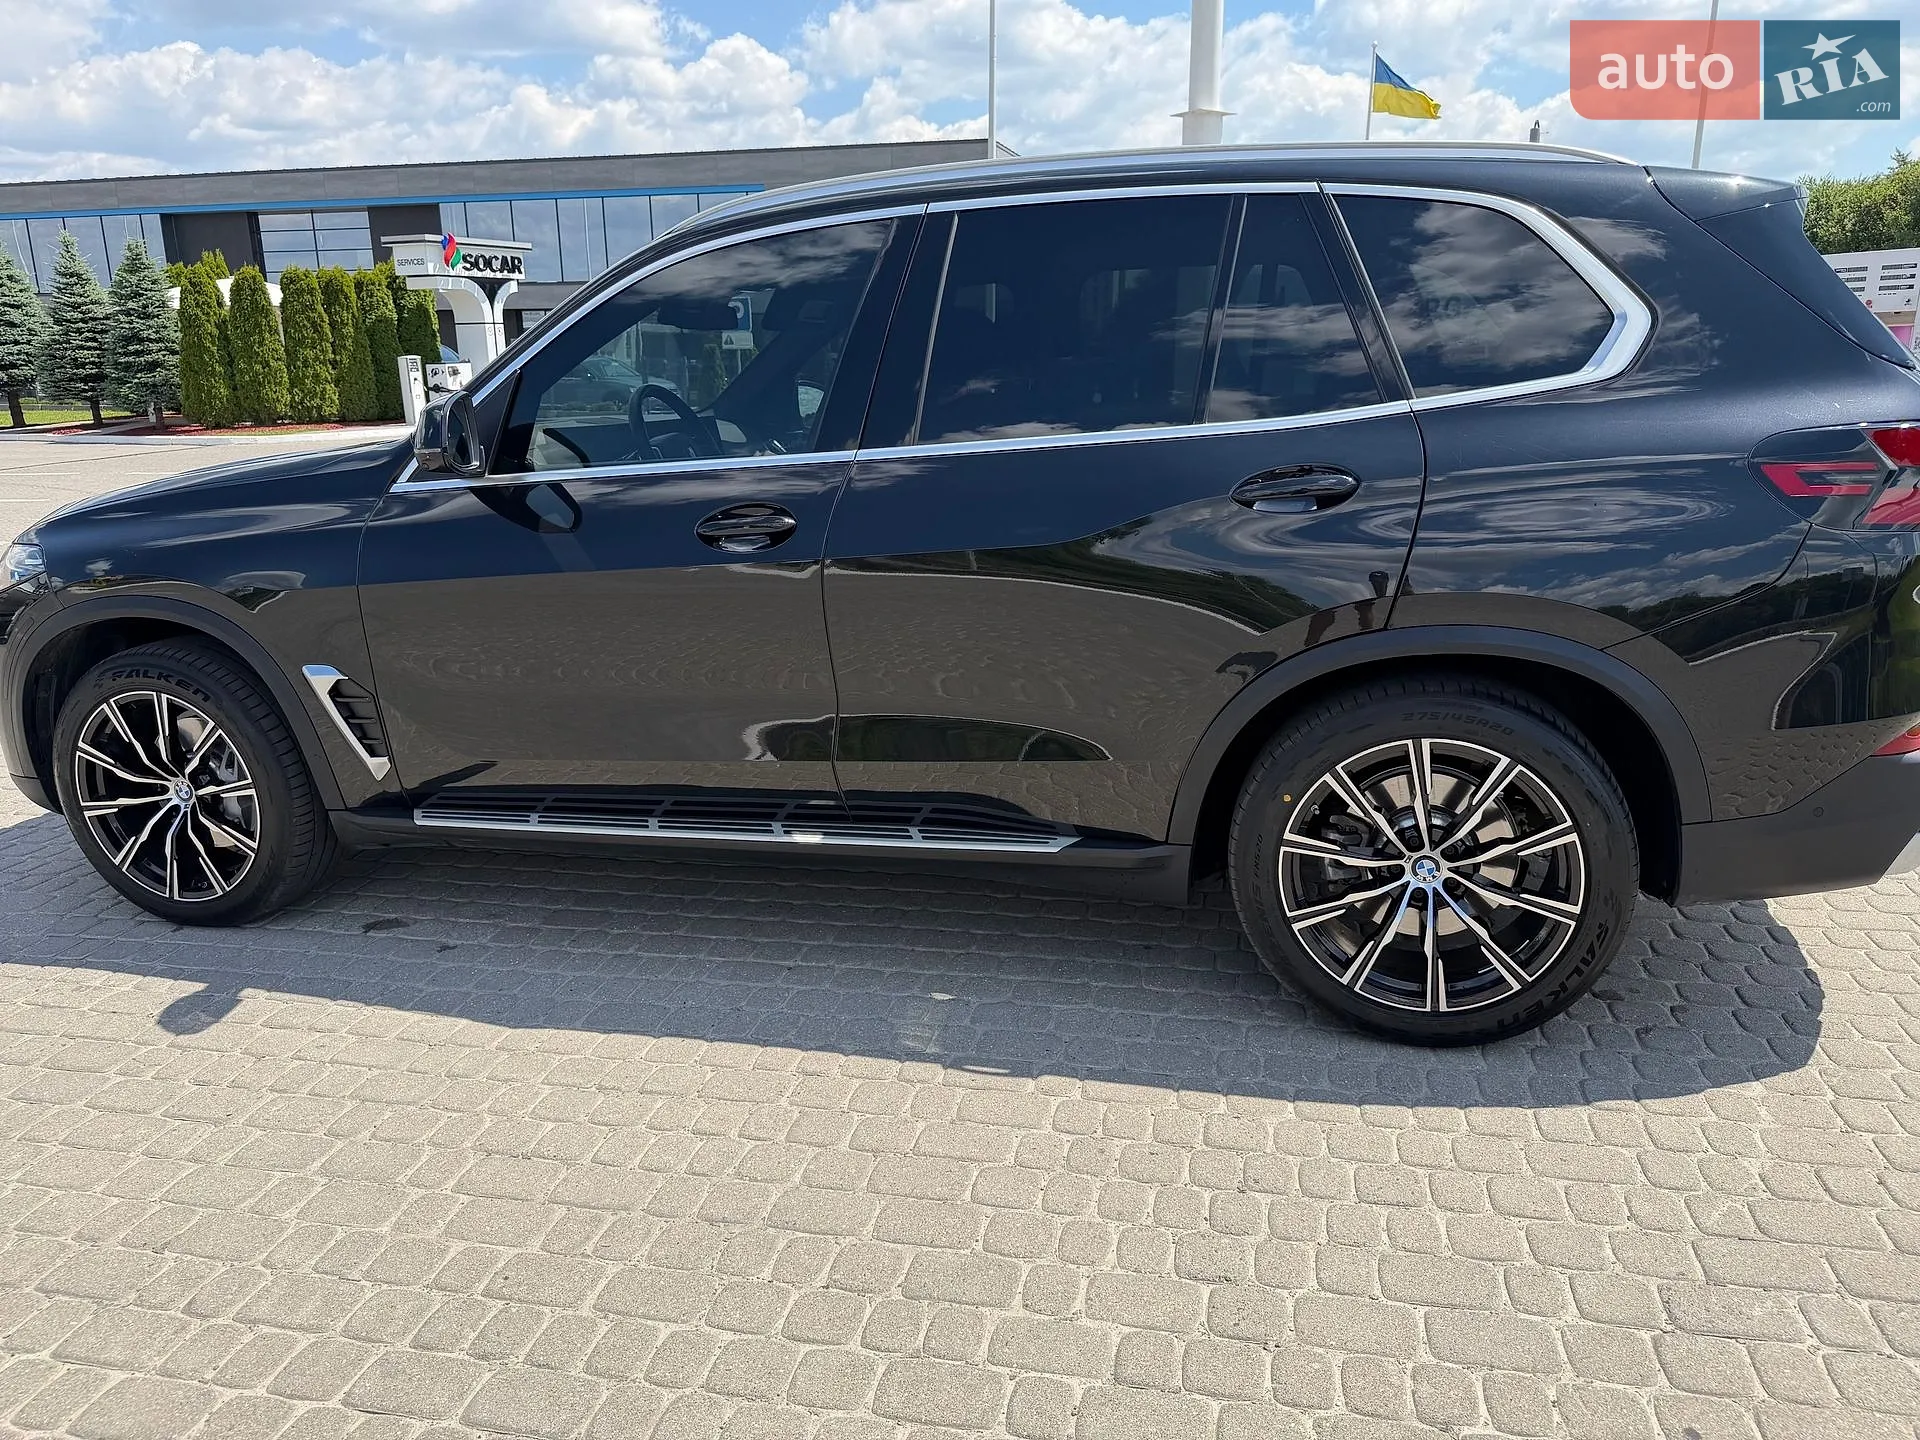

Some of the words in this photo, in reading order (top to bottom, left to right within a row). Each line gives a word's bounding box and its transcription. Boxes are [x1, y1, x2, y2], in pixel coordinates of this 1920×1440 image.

[397, 258, 425, 267] SERVICES
[461, 252, 523, 275] SOCAR
[111, 668, 212, 703] FALKEN
[1496, 919, 1609, 1030] FALKEN
